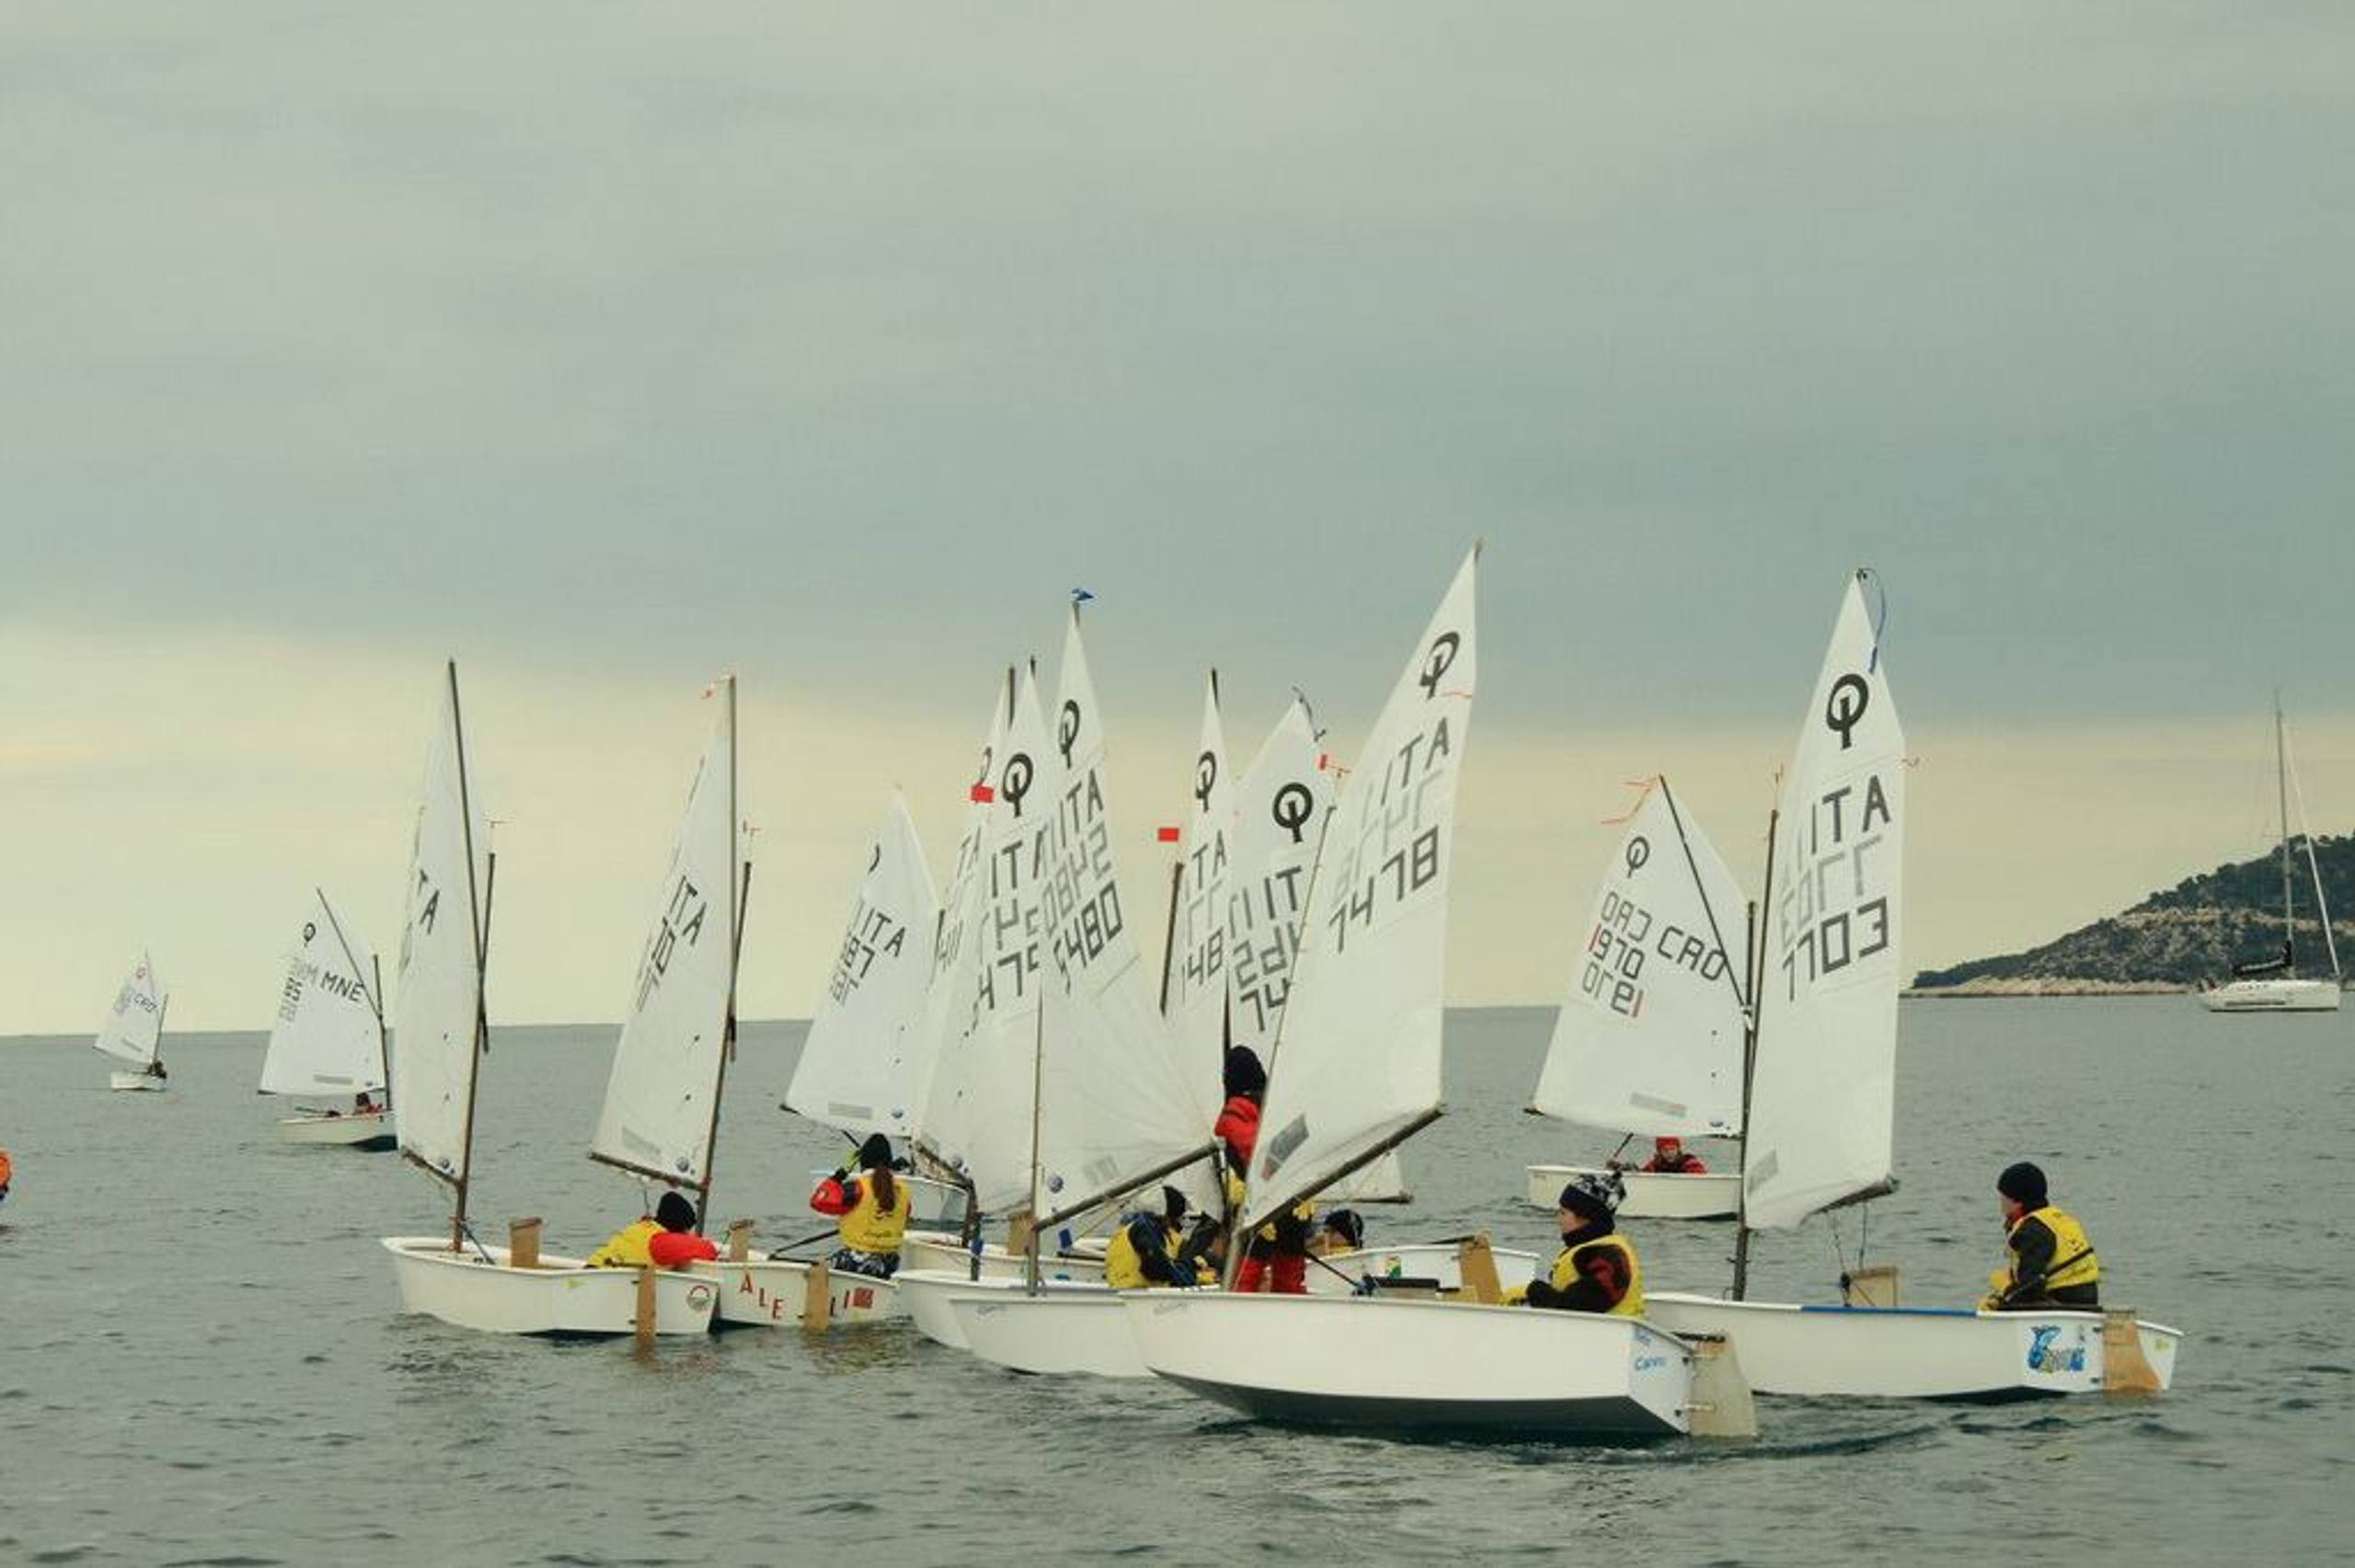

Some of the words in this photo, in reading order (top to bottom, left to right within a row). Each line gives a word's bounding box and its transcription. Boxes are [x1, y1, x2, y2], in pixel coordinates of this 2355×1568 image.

[1381, 715, 1450, 807] ITA
[1059, 767, 1104, 849] ITA
[1810, 773, 1891, 855] ITA
[1329, 825, 1440, 954] 7478
[860, 907, 907, 958] ITA
[1588, 922, 1646, 981] 1970
[1657, 925, 1727, 981] CRO
[1782, 896, 1889, 1002] 7703
[319, 969, 365, 1002] MNE
